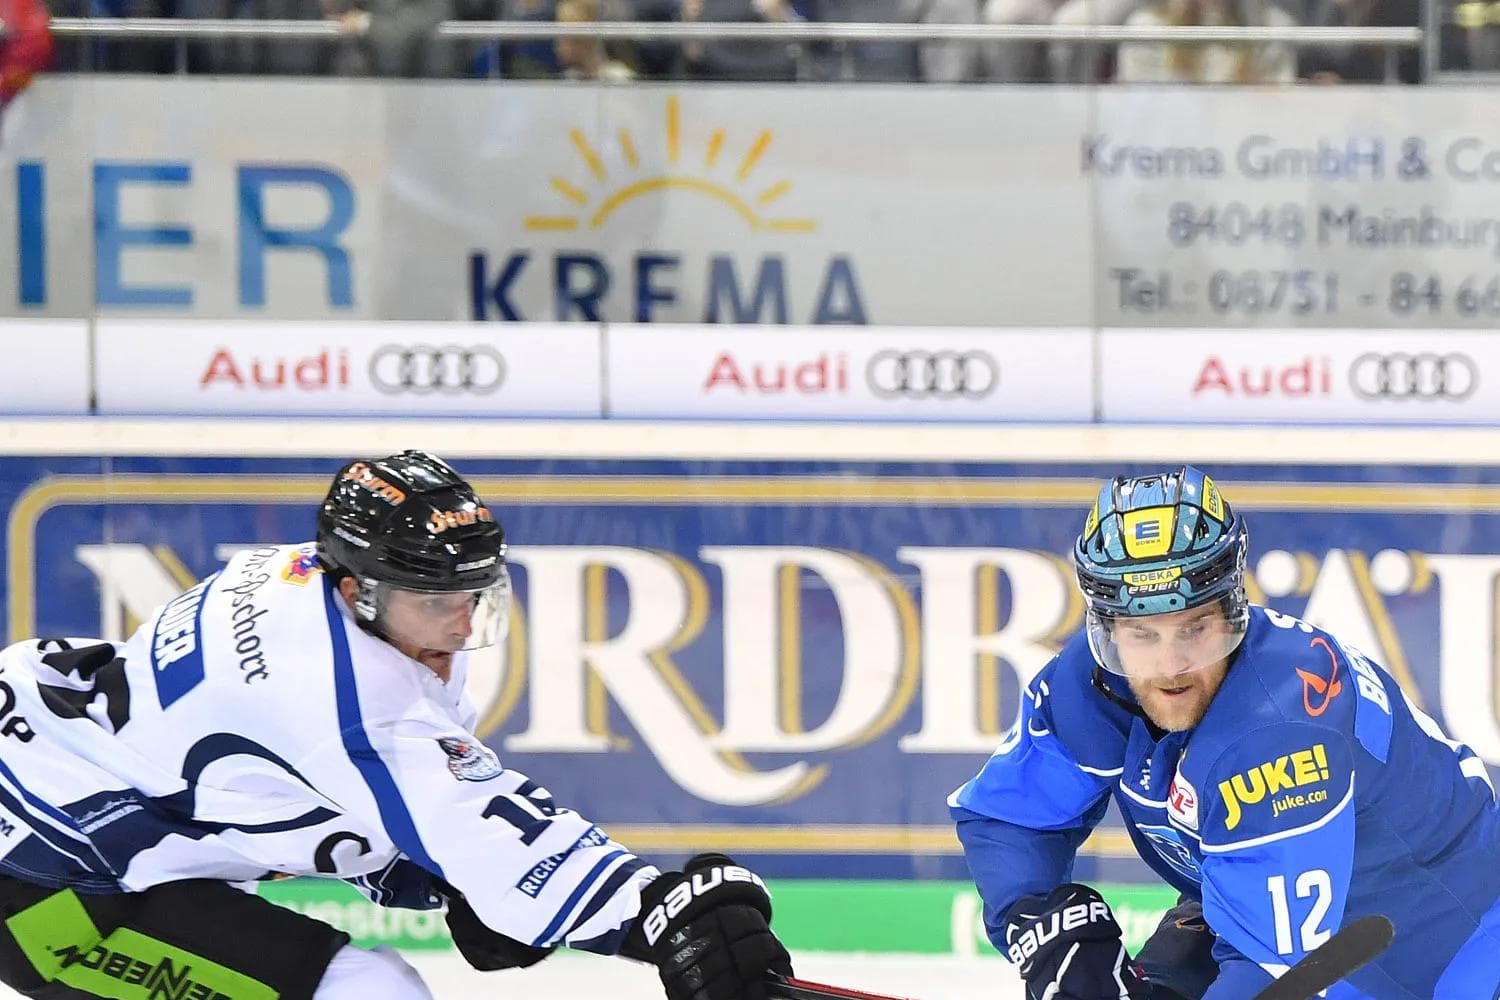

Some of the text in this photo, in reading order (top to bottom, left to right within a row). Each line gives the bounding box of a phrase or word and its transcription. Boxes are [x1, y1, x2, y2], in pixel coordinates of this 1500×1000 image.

[1080, 136, 1226, 180] Krema
[1238, 136, 1384, 180] GmbH
[202, 348, 349, 390] Audi
[704, 352, 849, 395] Audi
[1193, 356, 1332, 399] Audi
[1131, 571, 1175, 583] EDEKA
[1218, 744, 1330, 830] JUKE!
[1267, 869, 1334, 956] 12
[1008, 901, 1110, 969] BAUER
